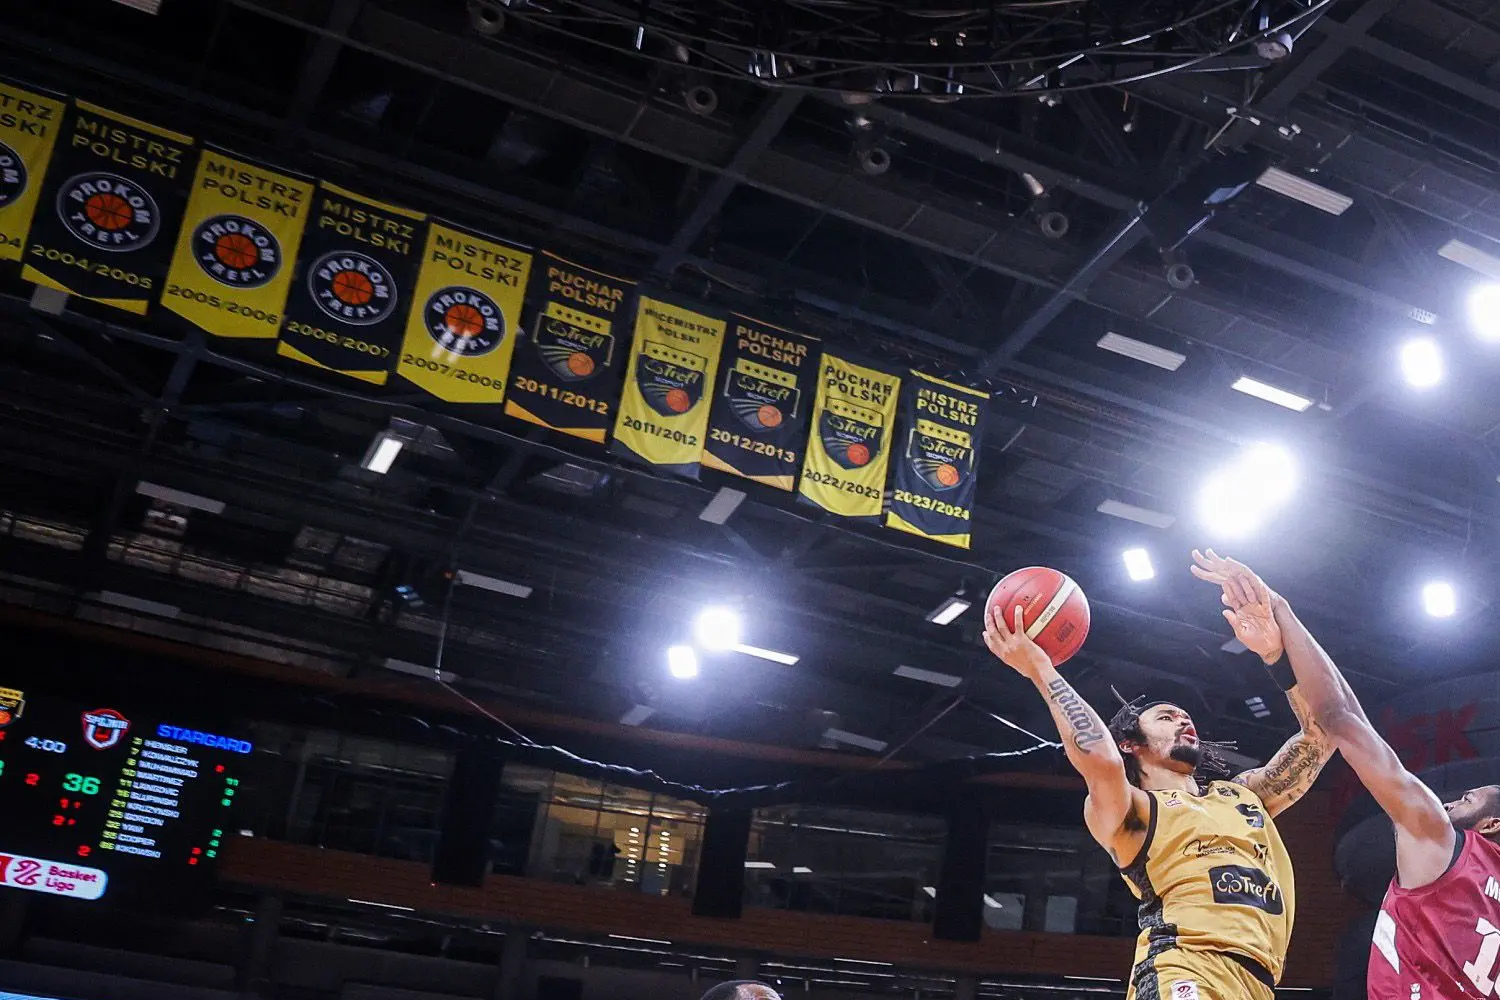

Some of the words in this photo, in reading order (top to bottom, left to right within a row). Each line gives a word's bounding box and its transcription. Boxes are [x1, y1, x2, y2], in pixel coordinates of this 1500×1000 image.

[72, 134, 177, 179] POLSKI
[77, 116, 183, 163] MISTRZ
[203, 177, 298, 218] POLSKI
[206, 160, 304, 202] MISTRZ
[69, 180, 151, 224] PROKOM
[323, 199, 415, 240] MISTRZ
[201, 220, 276, 263] PROKOM
[318, 215, 410, 256] POLSKI
[436, 234, 523, 272] MISTRZ
[31, 244, 153, 289] 2004/2005
[317, 257, 389, 299] PROKOM
[431, 250, 519, 288] POLSKI
[548, 267, 624, 302] PUCHAR
[550, 280, 617, 313] POLSKI
[167, 284, 279, 325] 2005/2006
[431, 291, 499, 331] PROKOM
[644, 307, 719, 337] WICEMISTRZ
[287, 320, 390, 358] 2006/2007
[657, 324, 700, 344] POLSKI
[736, 325, 808, 358] PUCHAR
[738, 338, 801, 367] POLSKI
[401, 353, 503, 391] 2007/2008
[825, 365, 893, 397] PUCHAR
[514, 375, 609, 415] 2011/2012
[827, 378, 886, 407] POLSKI
[918, 387, 978, 416] MISTRZ
[916, 398, 977, 427] POLSKI
[623, 415, 697, 446] 2011/2012
[710, 427, 795, 463] 2012/2013
[804, 468, 880, 500] 2022/2023
[894, 488, 970, 521] 2023/2024
[25, 736, 66, 754] 4:00
[157, 724, 252, 754] STARGARD
[62, 772, 101, 796] 36
[49, 865, 97, 883] Basket
[1240, 876, 1278, 904] Trefl
